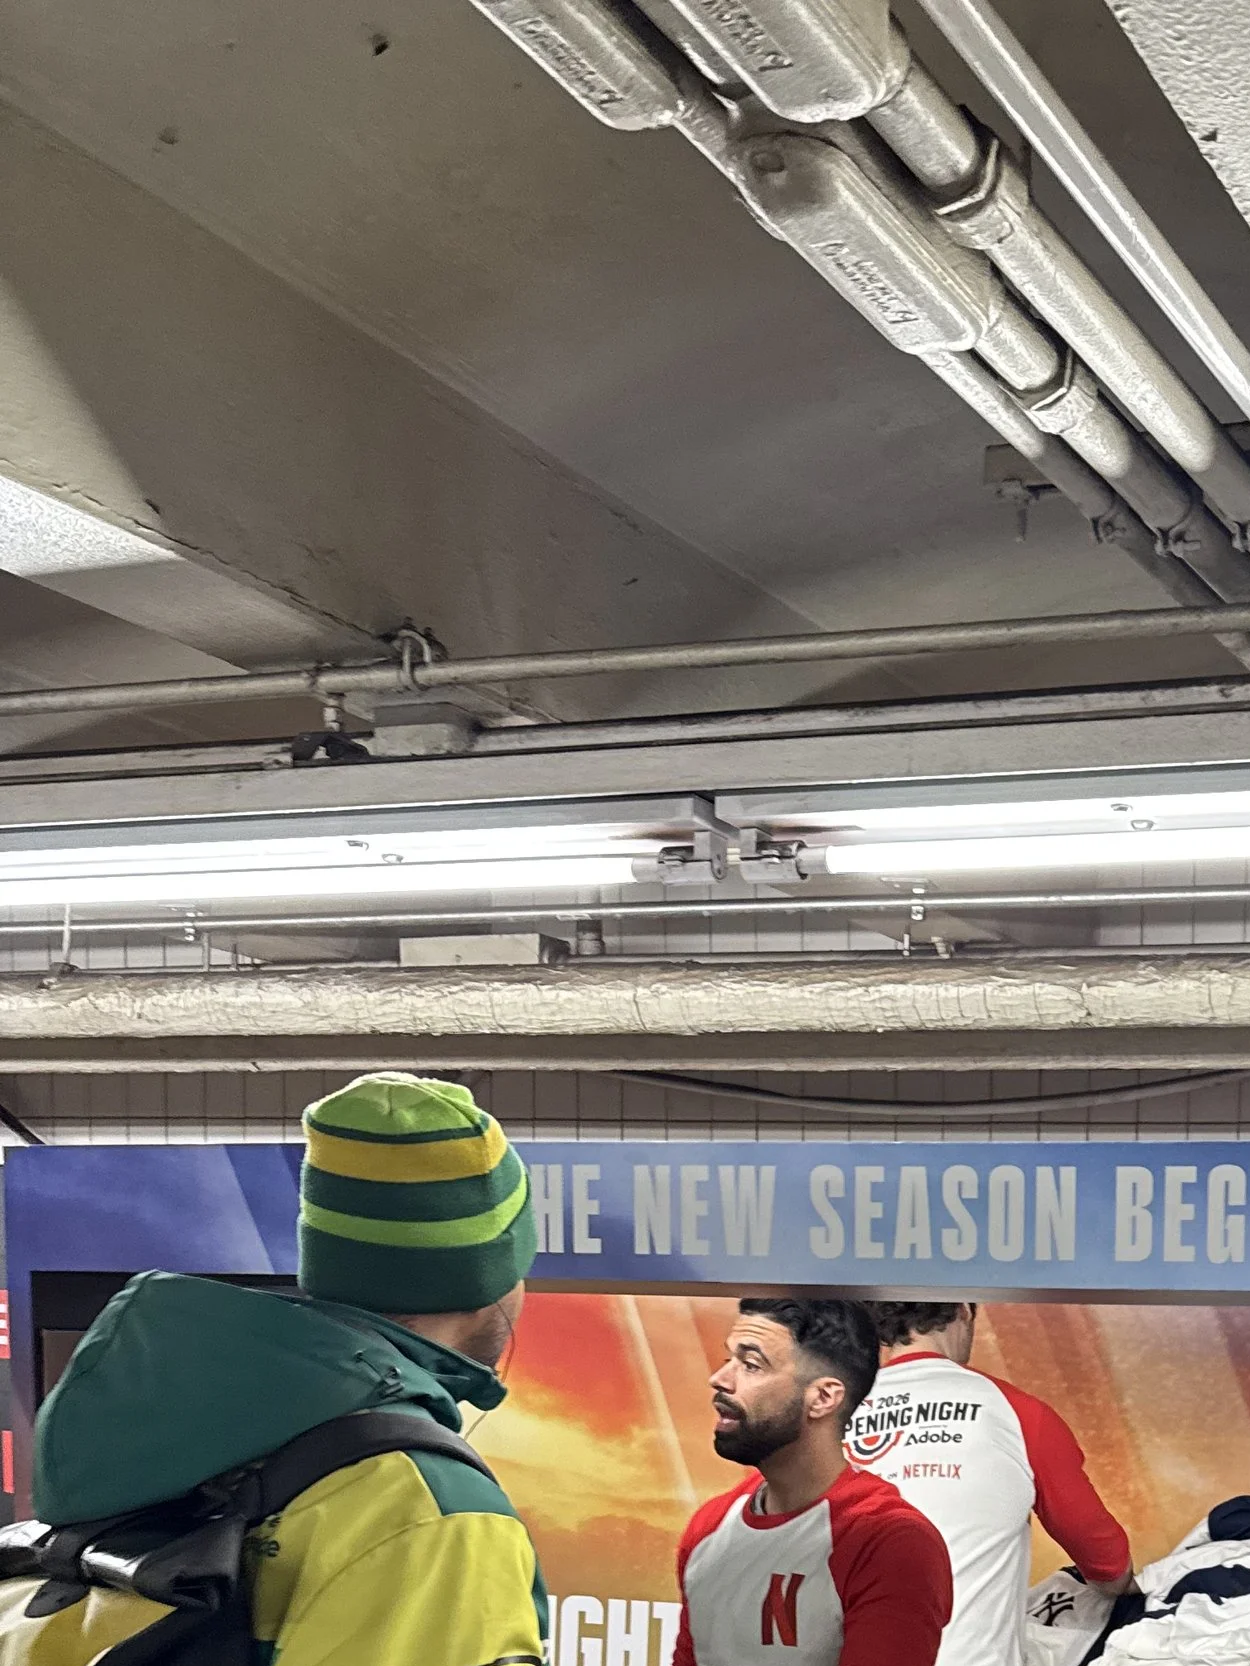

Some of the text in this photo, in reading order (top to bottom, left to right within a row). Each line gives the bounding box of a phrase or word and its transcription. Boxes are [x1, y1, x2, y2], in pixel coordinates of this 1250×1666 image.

[531, 1164, 602, 1255] HE
[633, 1164, 776, 1257] NEW
[808, 1164, 1078, 1263] SEASON
[915, 1402, 981, 1424] NIGHT
[904, 1430, 963, 1446] Adobe
[903, 1463, 962, 1480] NETFLIX
[762, 1573, 807, 1647] N
